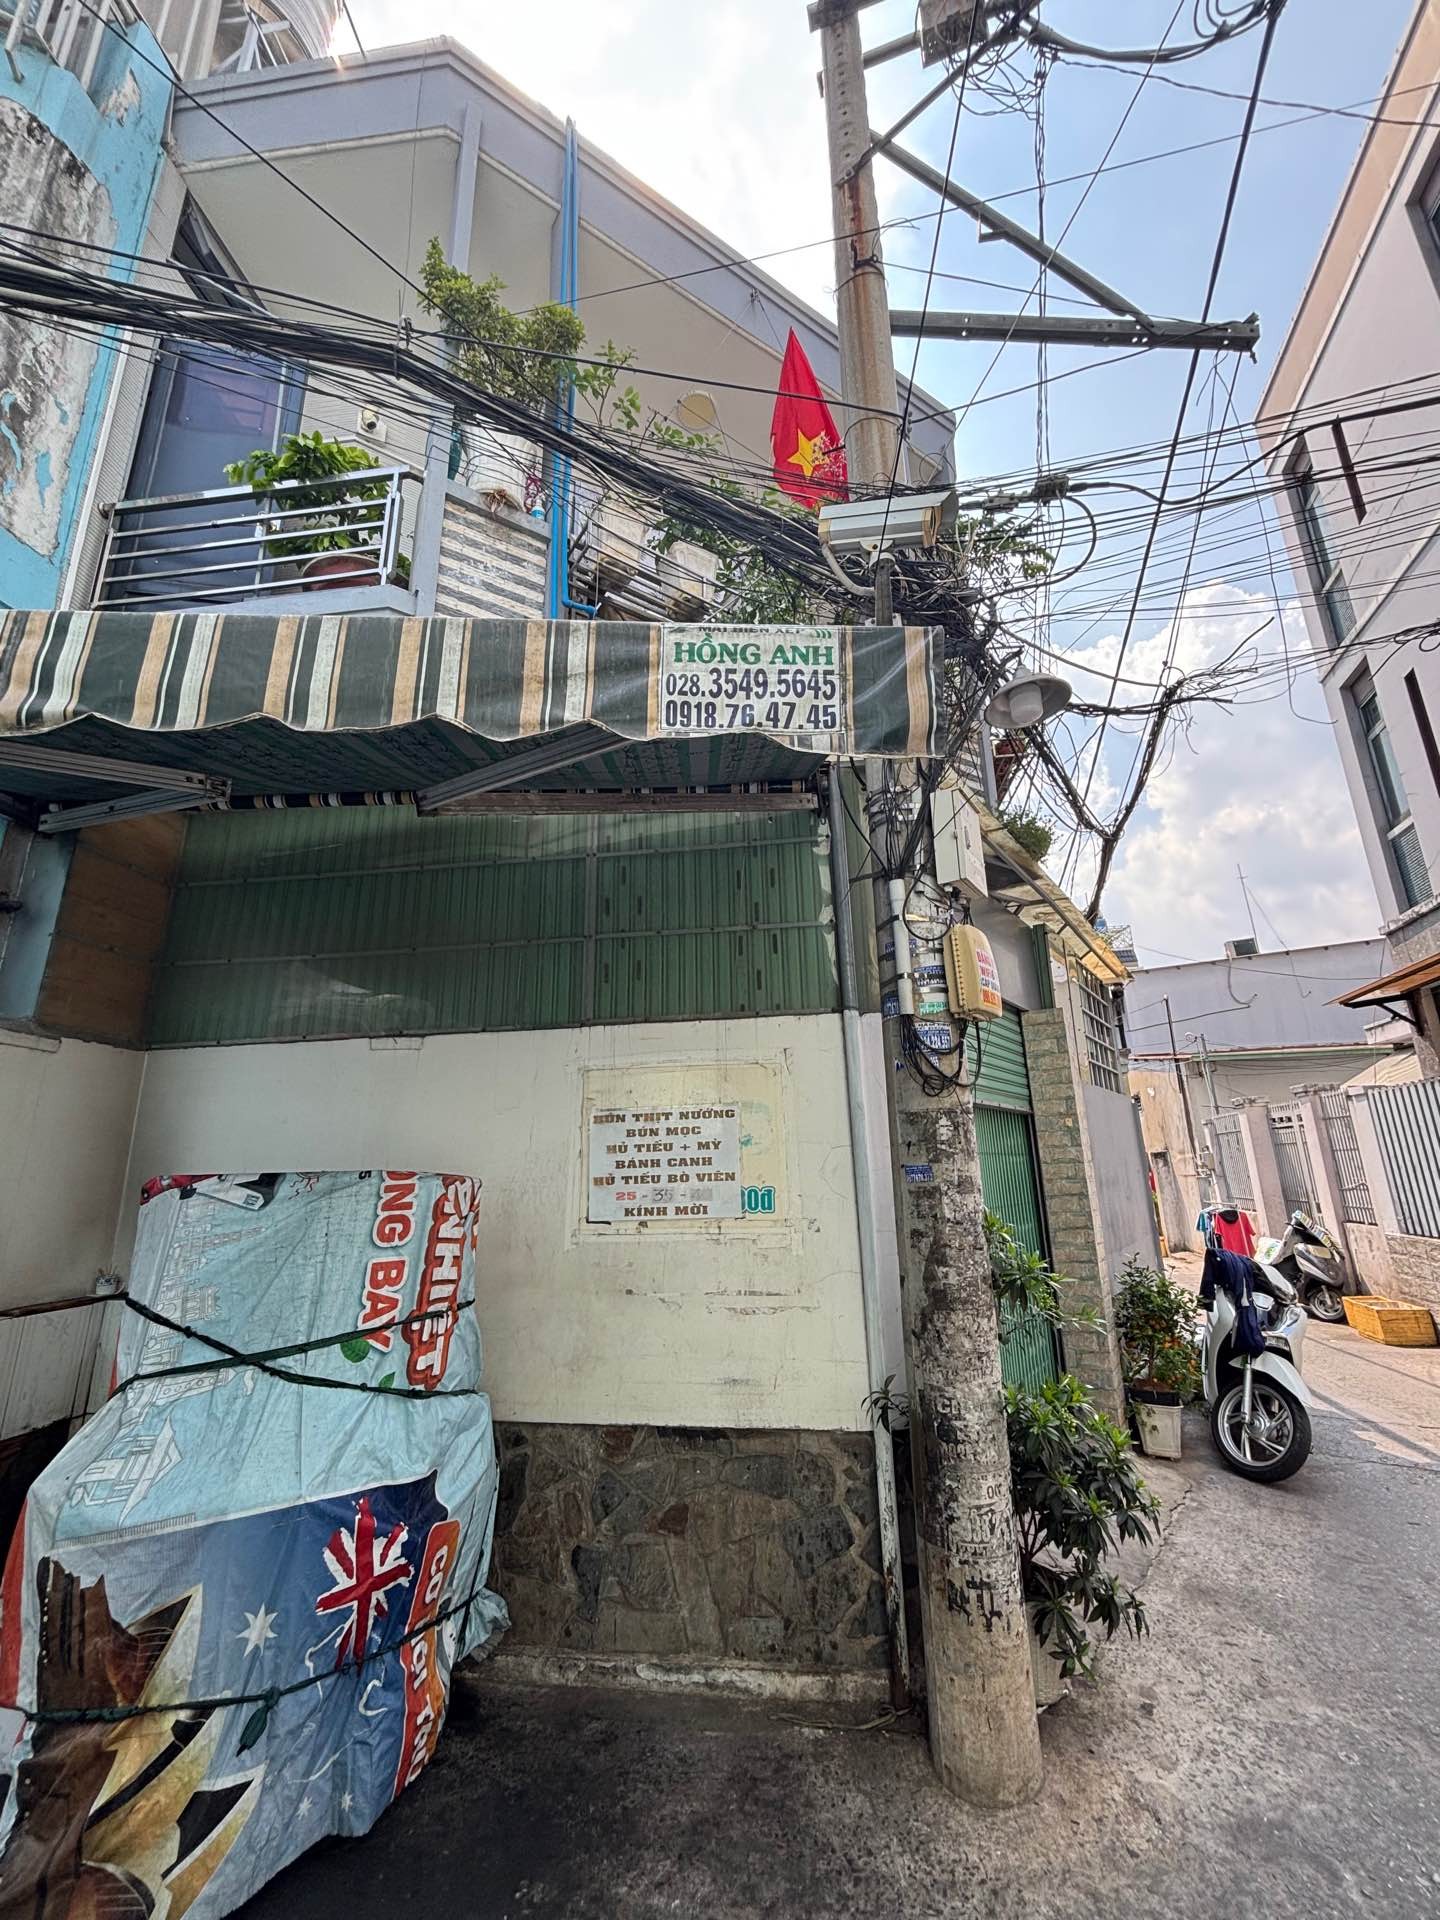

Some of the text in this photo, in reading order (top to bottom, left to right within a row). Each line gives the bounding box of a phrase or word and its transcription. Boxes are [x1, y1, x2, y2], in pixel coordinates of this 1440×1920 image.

[673, 633, 834, 665] HỒNG ANH
[665, 667, 836, 700] 028.3549.5645
[665, 699, 837, 729] 0918.76.47.45
[632, 1112, 673, 1124] THỊT
[679, 1108, 736, 1120] NƯỚNG
[626, 1126, 702, 1138] BÚN MỌC
[634, 1139, 674, 1153] TIẾU
[680, 1143, 691, 1151] +
[615, 1156, 713, 1170] BÁNH CANH
[621, 1171, 662, 1185] TIẾU
[667, 1171, 690, 1184] BÒ
[615, 1191, 637, 1201] 25
[624, 1202, 709, 1217] KÍNH MỜI
[362, 1258, 407, 1353] BAY
